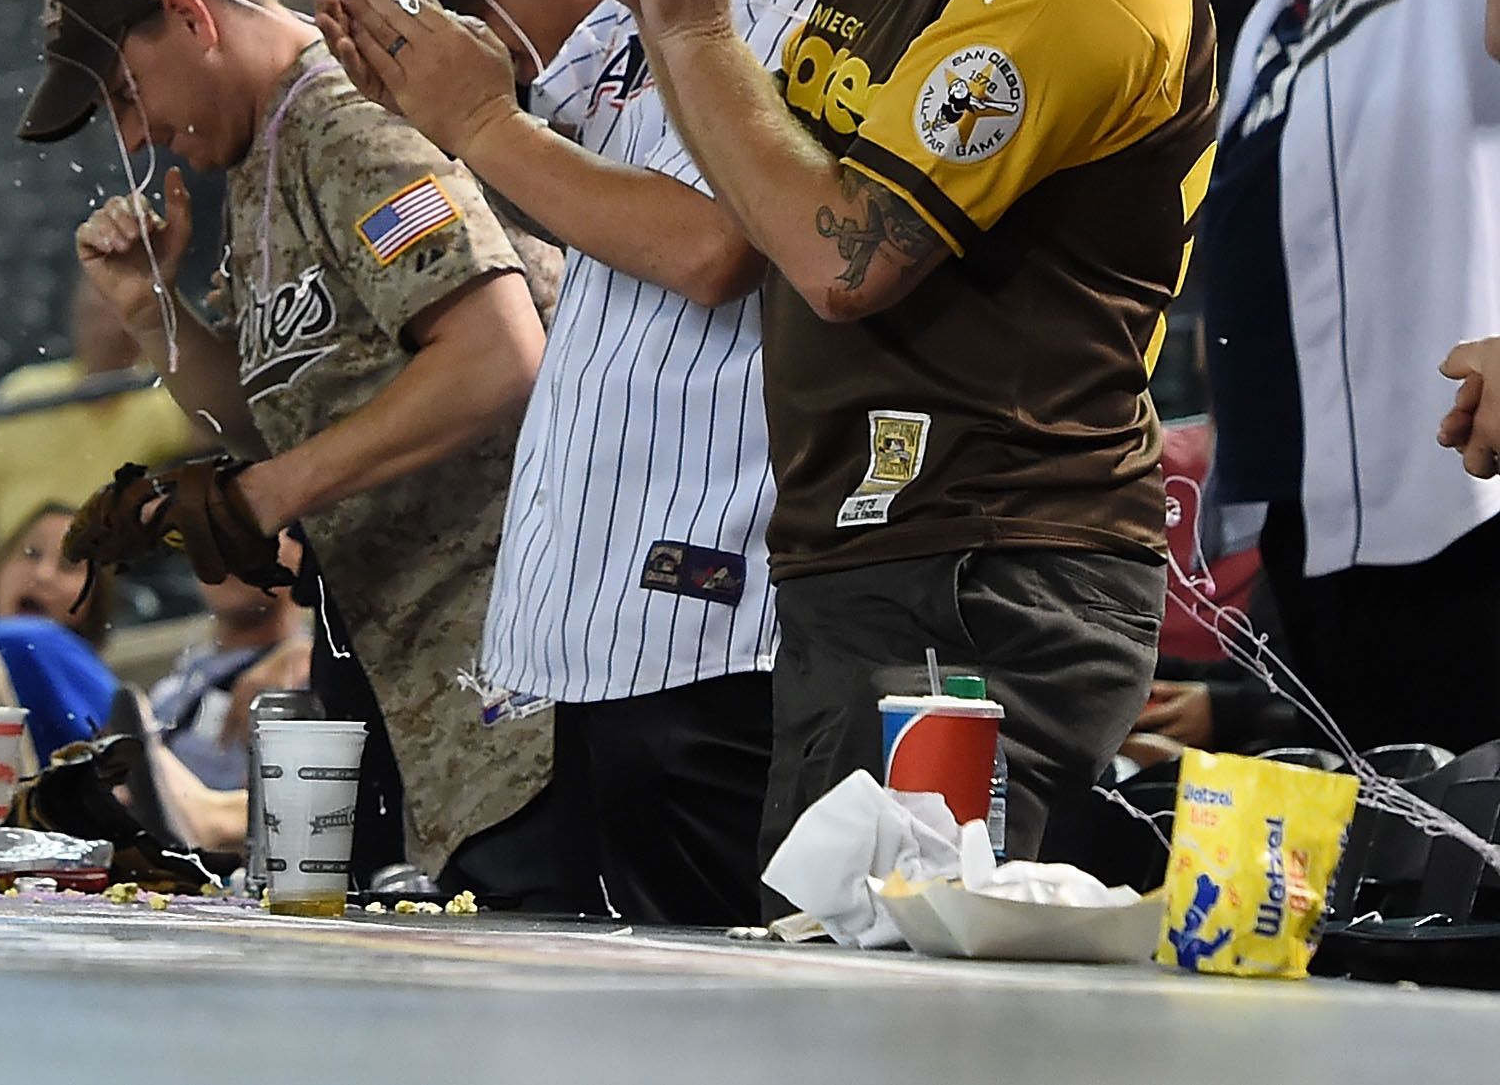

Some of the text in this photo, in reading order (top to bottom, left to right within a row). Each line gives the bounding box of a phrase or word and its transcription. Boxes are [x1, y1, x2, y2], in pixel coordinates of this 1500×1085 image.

[952, 50, 1021, 101] SAN DIEGO
[969, 70, 998, 95] 1978
[955, 128, 1005, 157] GAME
